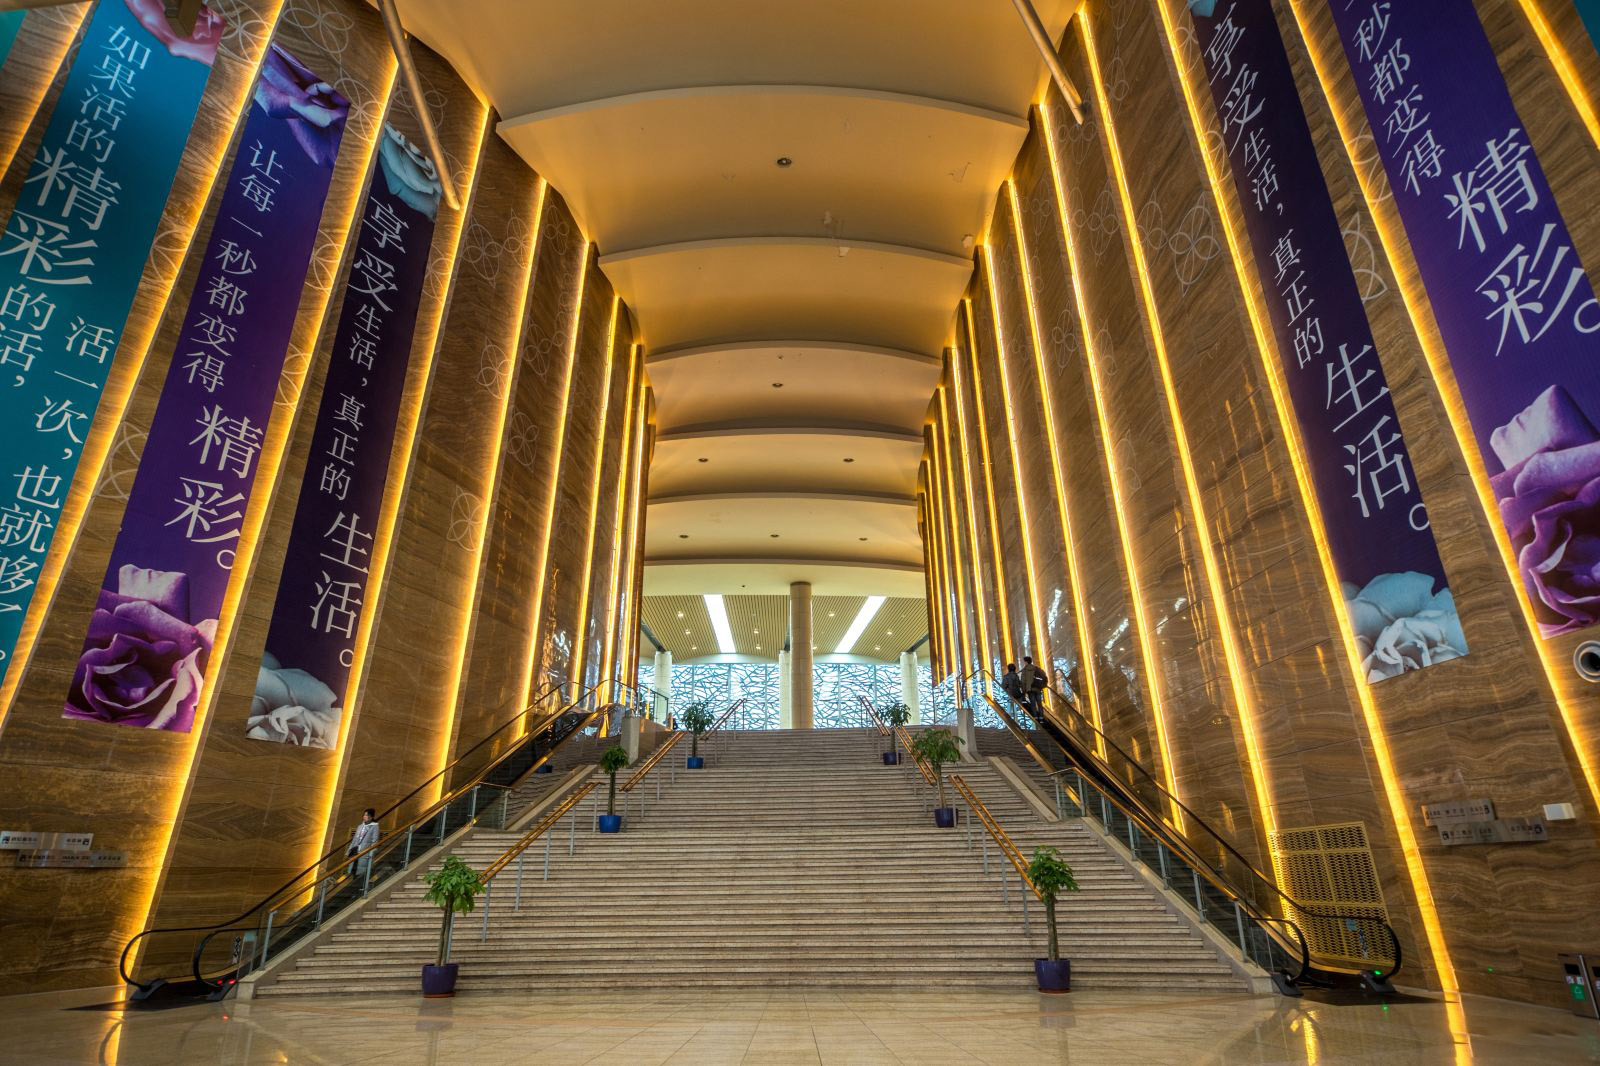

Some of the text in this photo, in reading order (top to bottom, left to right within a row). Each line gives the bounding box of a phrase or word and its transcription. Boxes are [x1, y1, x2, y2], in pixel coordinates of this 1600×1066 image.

[1344, 0, 1600, 357] 秒都变得精彩。
